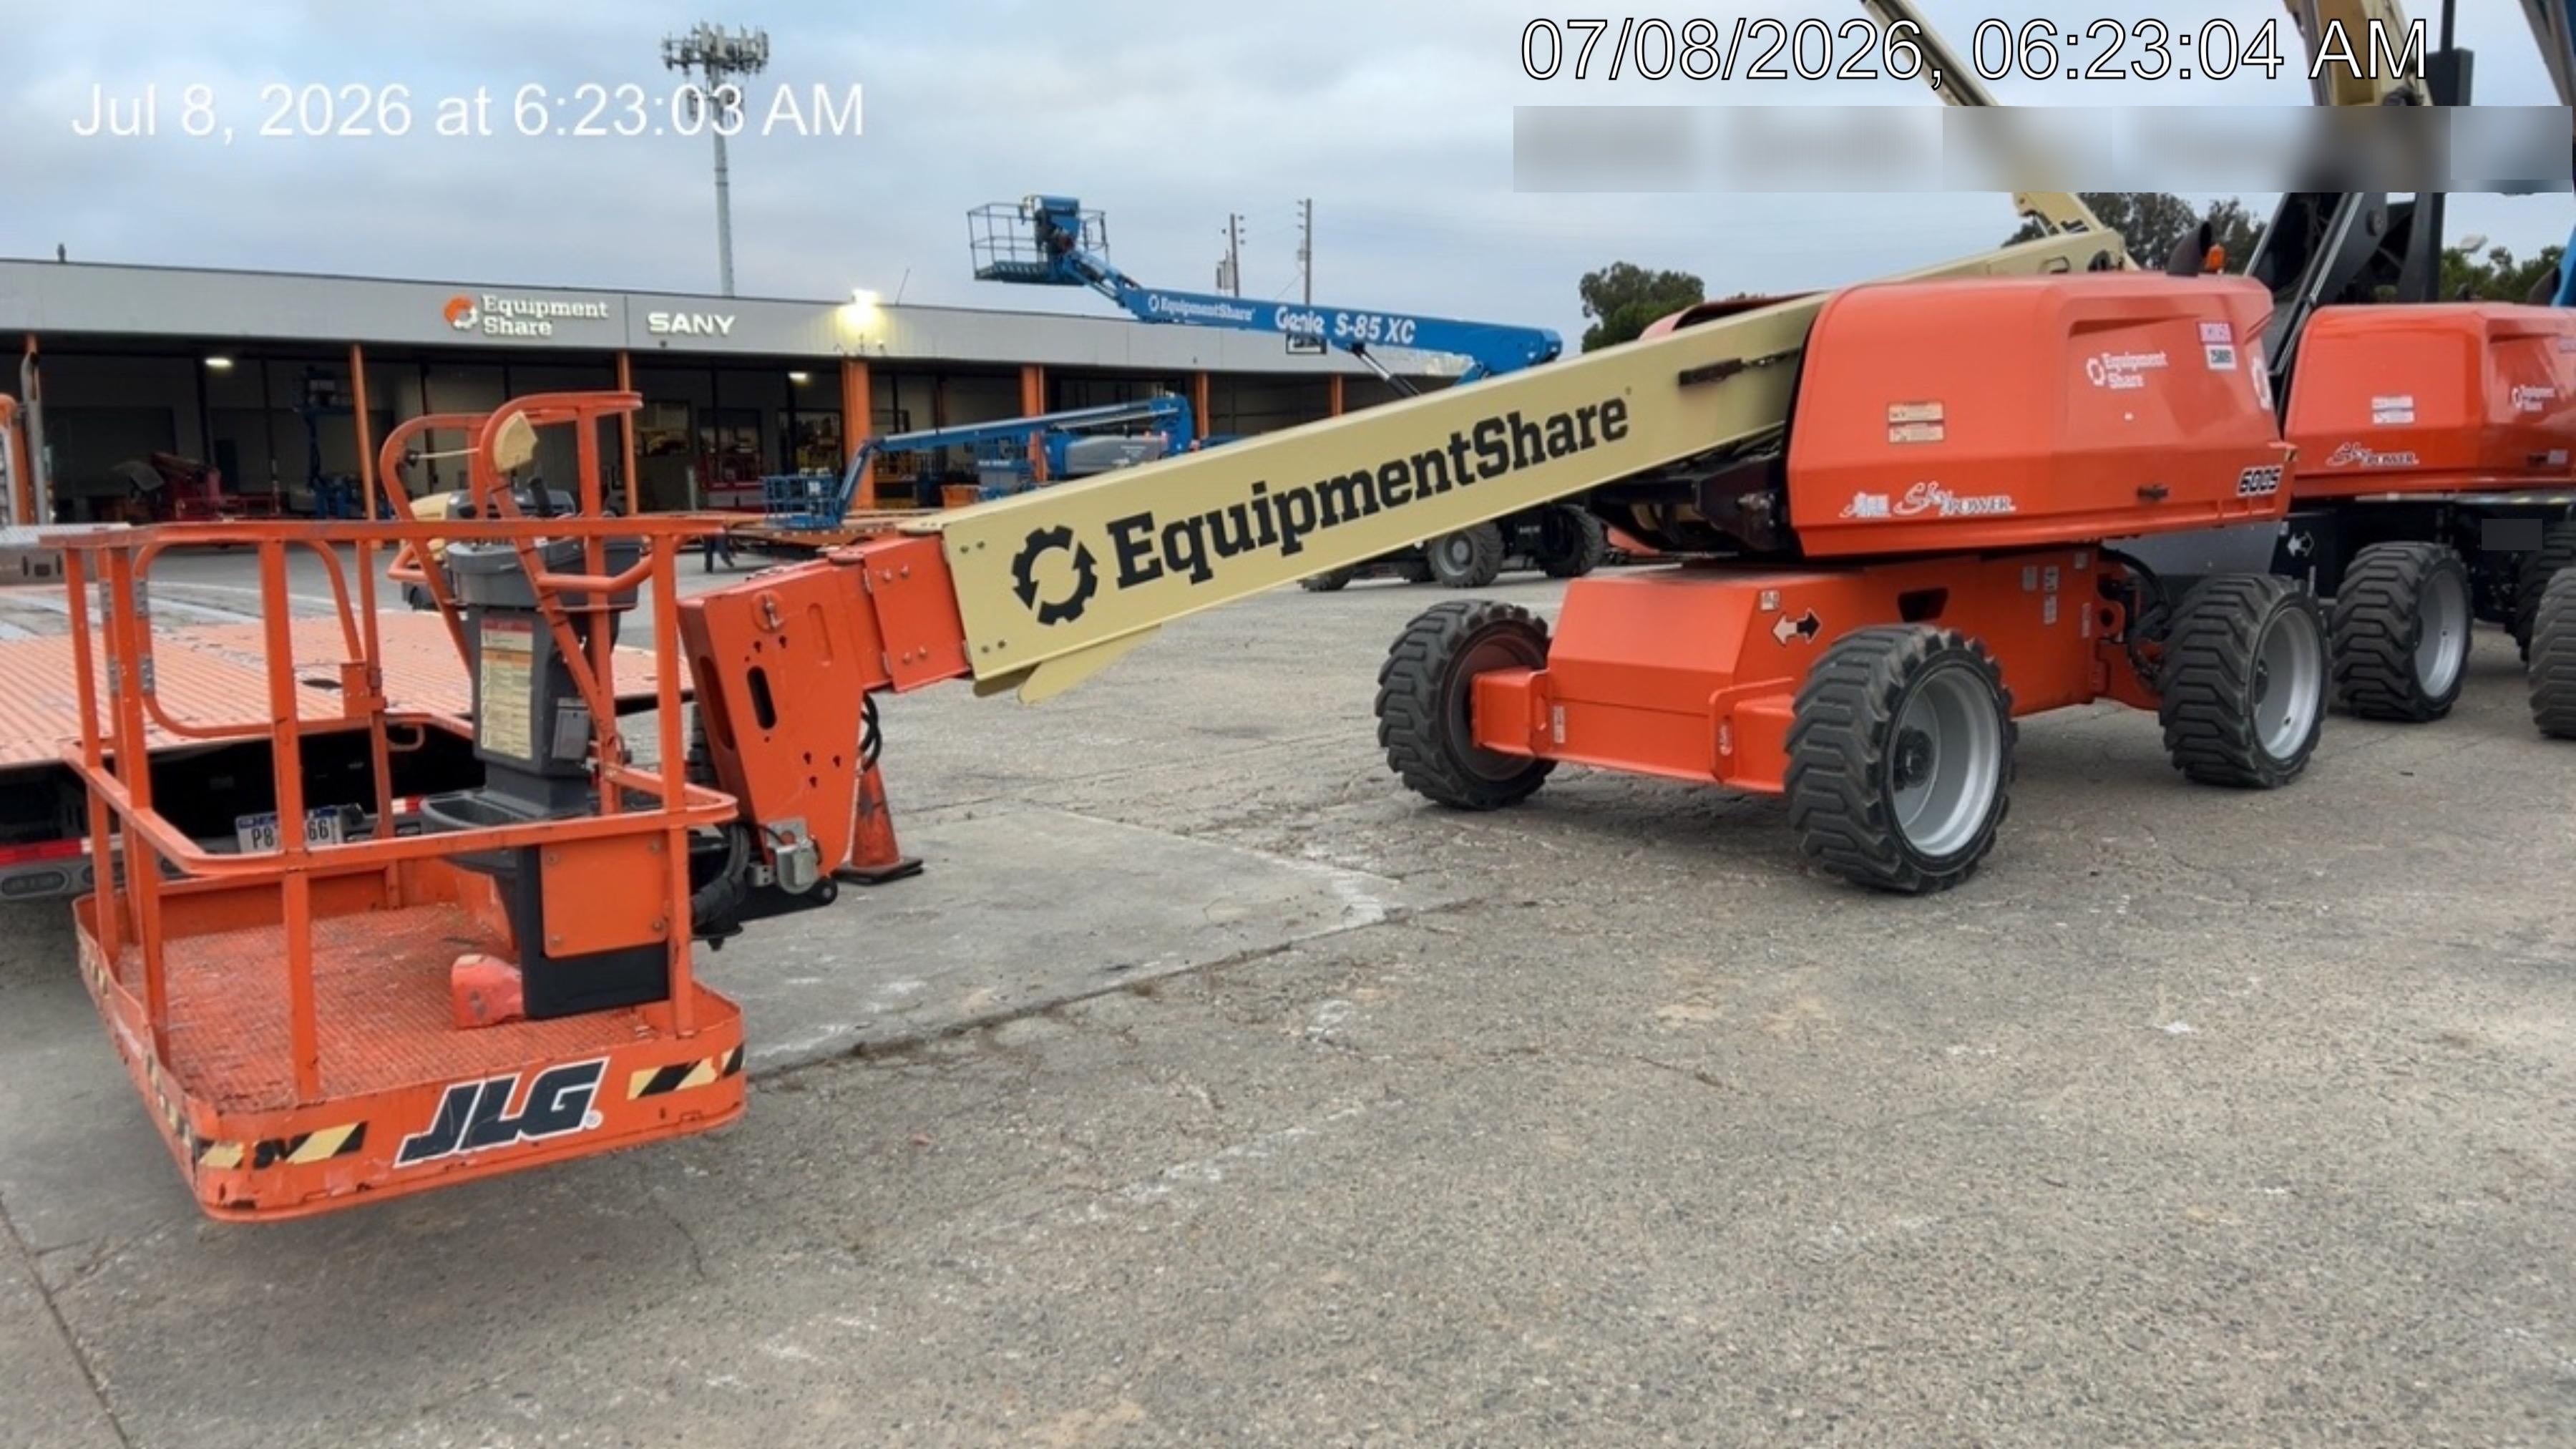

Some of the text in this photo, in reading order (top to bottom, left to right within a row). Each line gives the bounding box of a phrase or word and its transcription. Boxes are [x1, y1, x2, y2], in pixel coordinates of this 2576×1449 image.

[482, 294, 608, 319] Equipment
[483, 316, 552, 336] Share
[647, 311, 736, 335] SANY
[1274, 306, 1417, 344] Genie S-85 XC
[1106, 396, 1629, 589] EquipmentShare
[396, 1058, 607, 1164] JLG
